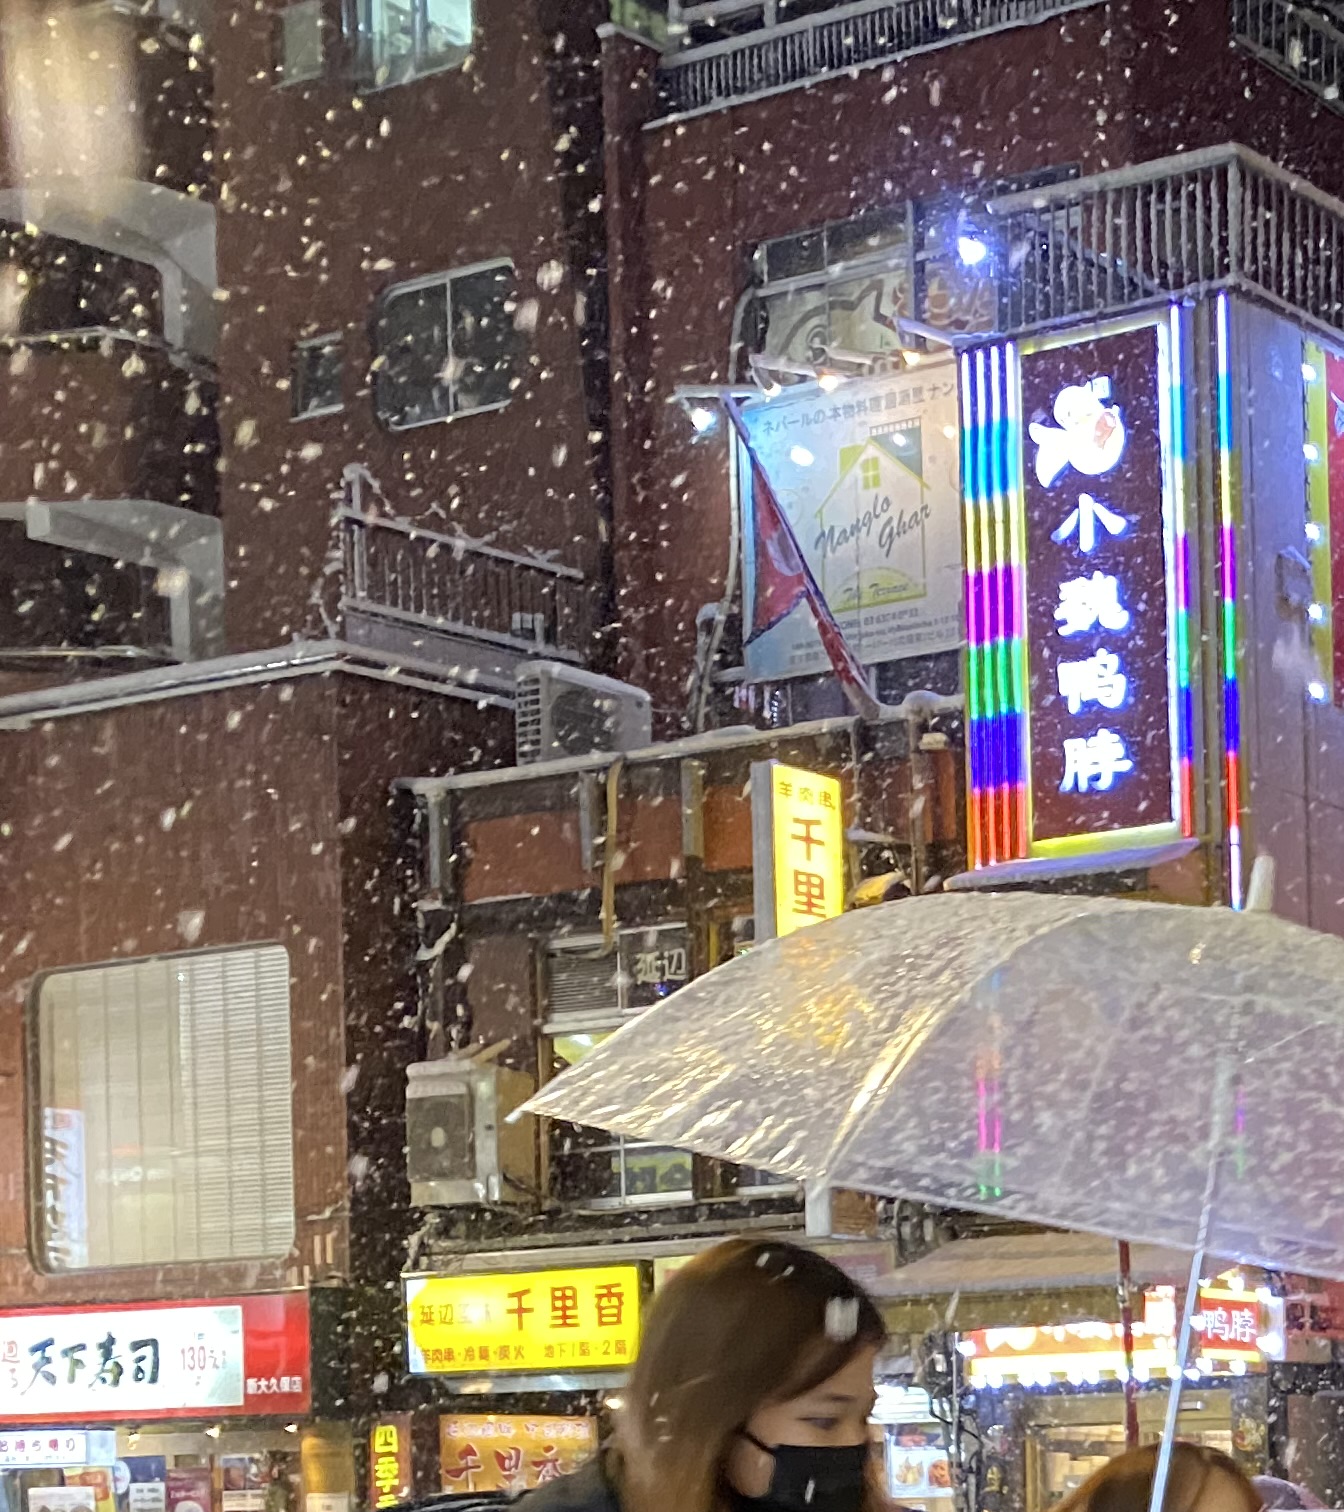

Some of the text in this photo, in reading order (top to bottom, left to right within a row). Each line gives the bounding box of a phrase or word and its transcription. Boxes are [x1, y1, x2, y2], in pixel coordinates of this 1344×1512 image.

[814, 493, 932, 558] Nanglo Ghar
[506, 1283, 625, 1331] 千里香
[20, 1331, 160, 1395] 天下寿司
[246, 1376, 303, 1395] 新大久保店
